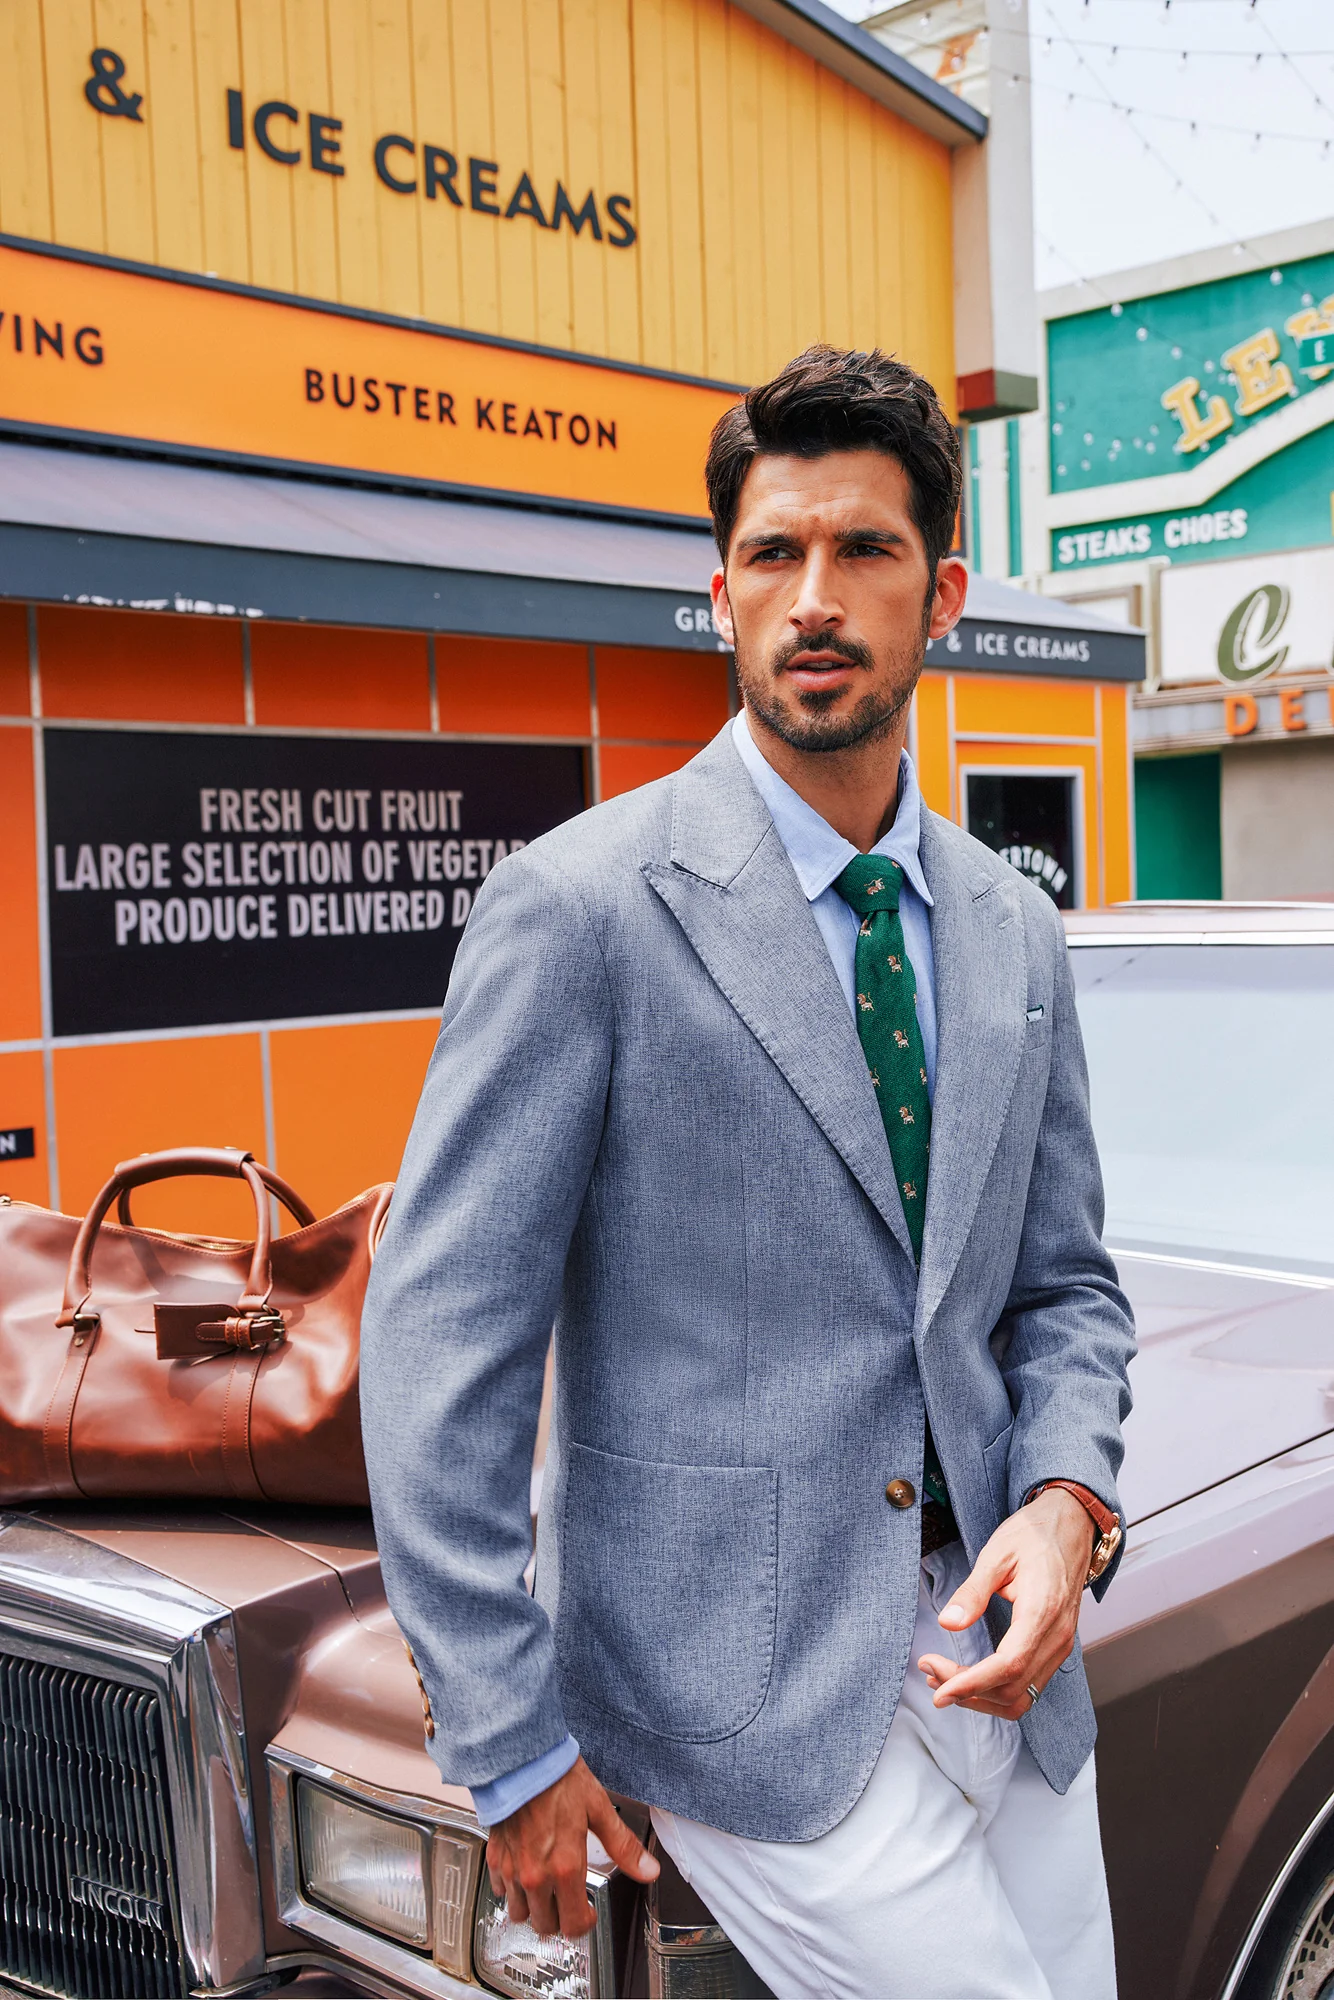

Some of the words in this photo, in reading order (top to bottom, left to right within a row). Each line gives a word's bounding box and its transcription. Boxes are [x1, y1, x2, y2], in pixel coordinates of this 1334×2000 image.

[85, 47, 144, 123] &
[226, 88, 345, 177] ICE
[374, 134, 637, 248] CREAMS
[0, 311, 103, 365] ING
[305, 368, 457, 426] BUSTER
[476, 397, 617, 449] KEATON
[1058, 523, 1151, 564] STEAKS
[976, 632, 1008, 656] ICE
[1013, 635, 1091, 662] CREAMS
[1223, 684, 1334, 737] DE
[200, 787, 303, 832] FRESH
[313, 789, 371, 832] CUT
[381, 789, 463, 832] FRUIT
[54, 843, 171, 891] LARGE
[182, 840, 352, 888] SELECTION
[362, 839, 400, 883] OF
[407, 838, 528, 882] VEGETA
[115, 896, 278, 946] PRODUCE
[288, 889, 445, 938] DELIVERED
[452, 886, 481, 928] D
[71, 1877, 162, 1931] LINCOLN
